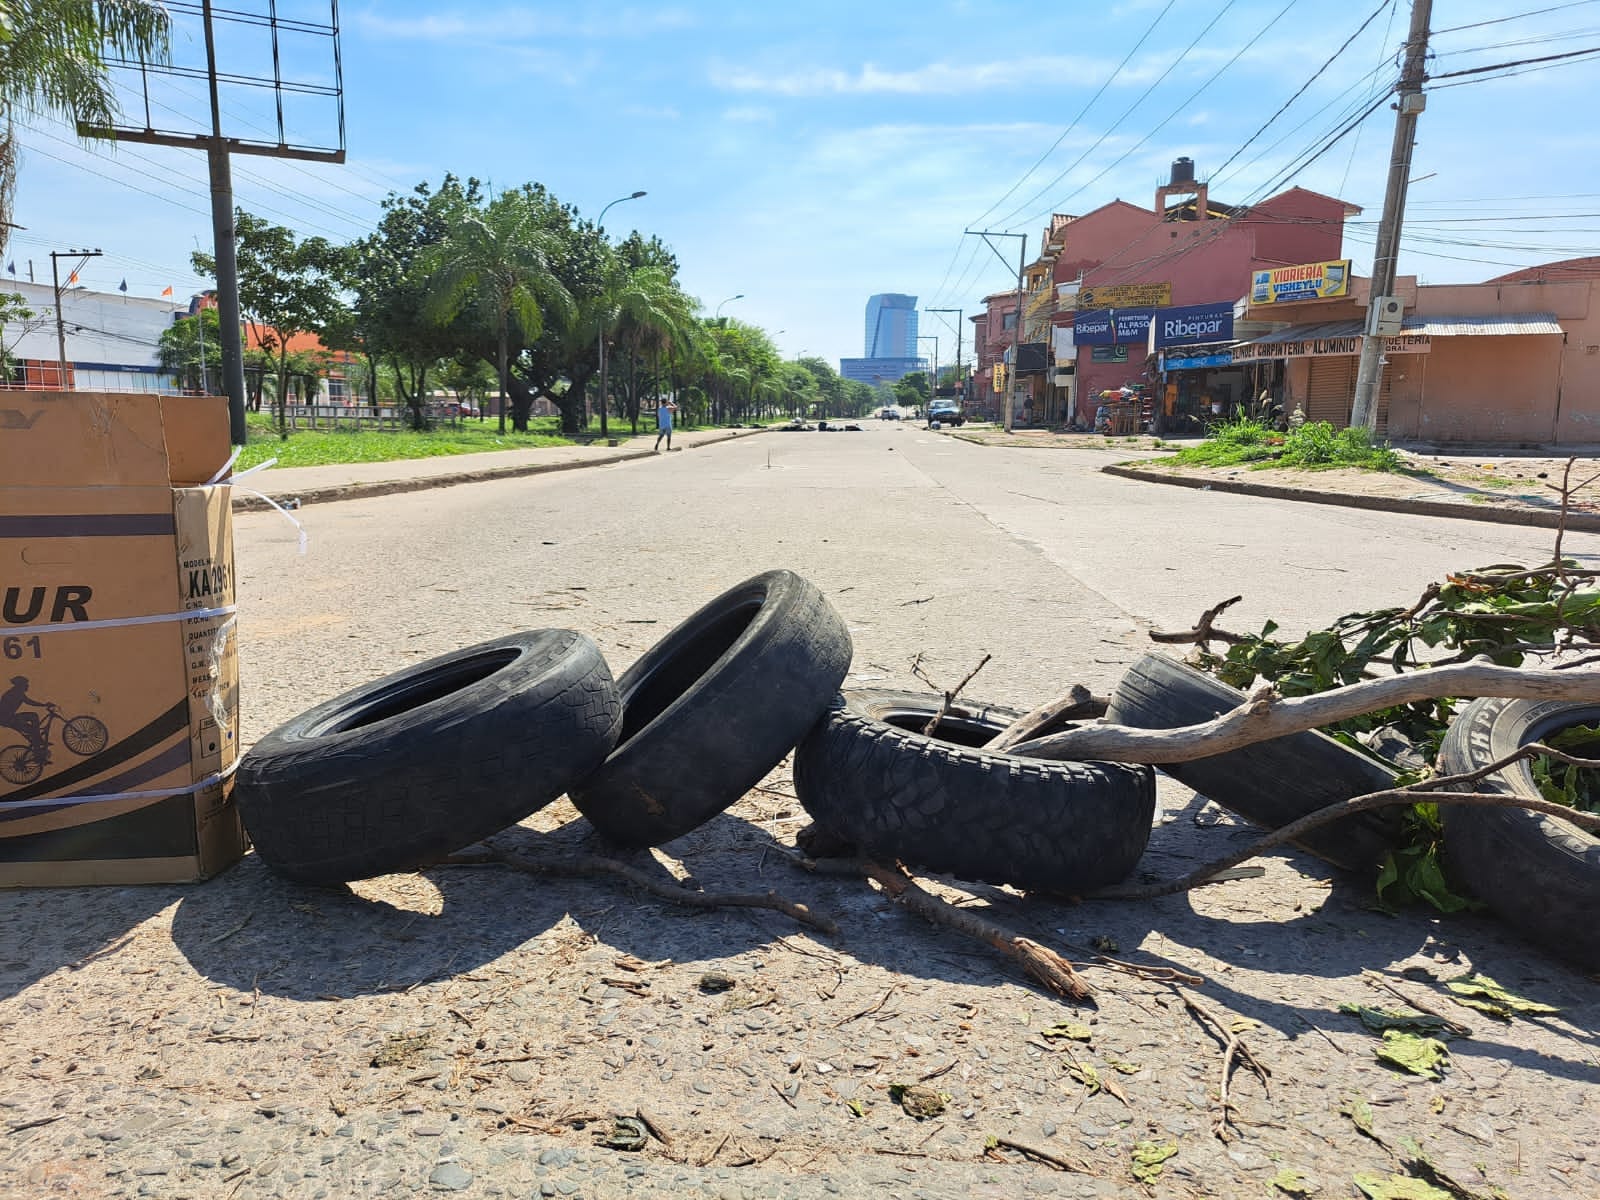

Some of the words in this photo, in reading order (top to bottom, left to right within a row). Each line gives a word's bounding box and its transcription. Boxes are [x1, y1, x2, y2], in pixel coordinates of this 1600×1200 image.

[1274, 265, 1323, 283] VIDRIERIA
[1076, 323, 1108, 334] Ribepar
[1119, 321, 1128, 329] AL
[1129, 320, 1150, 328] PASO
[1165, 319, 1222, 339] Ribepar
[1257, 341, 1305, 357] CARPINTERIA
[1313, 337, 1355, 354] ALUMINIO
[3, 635, 42, 660] 61
